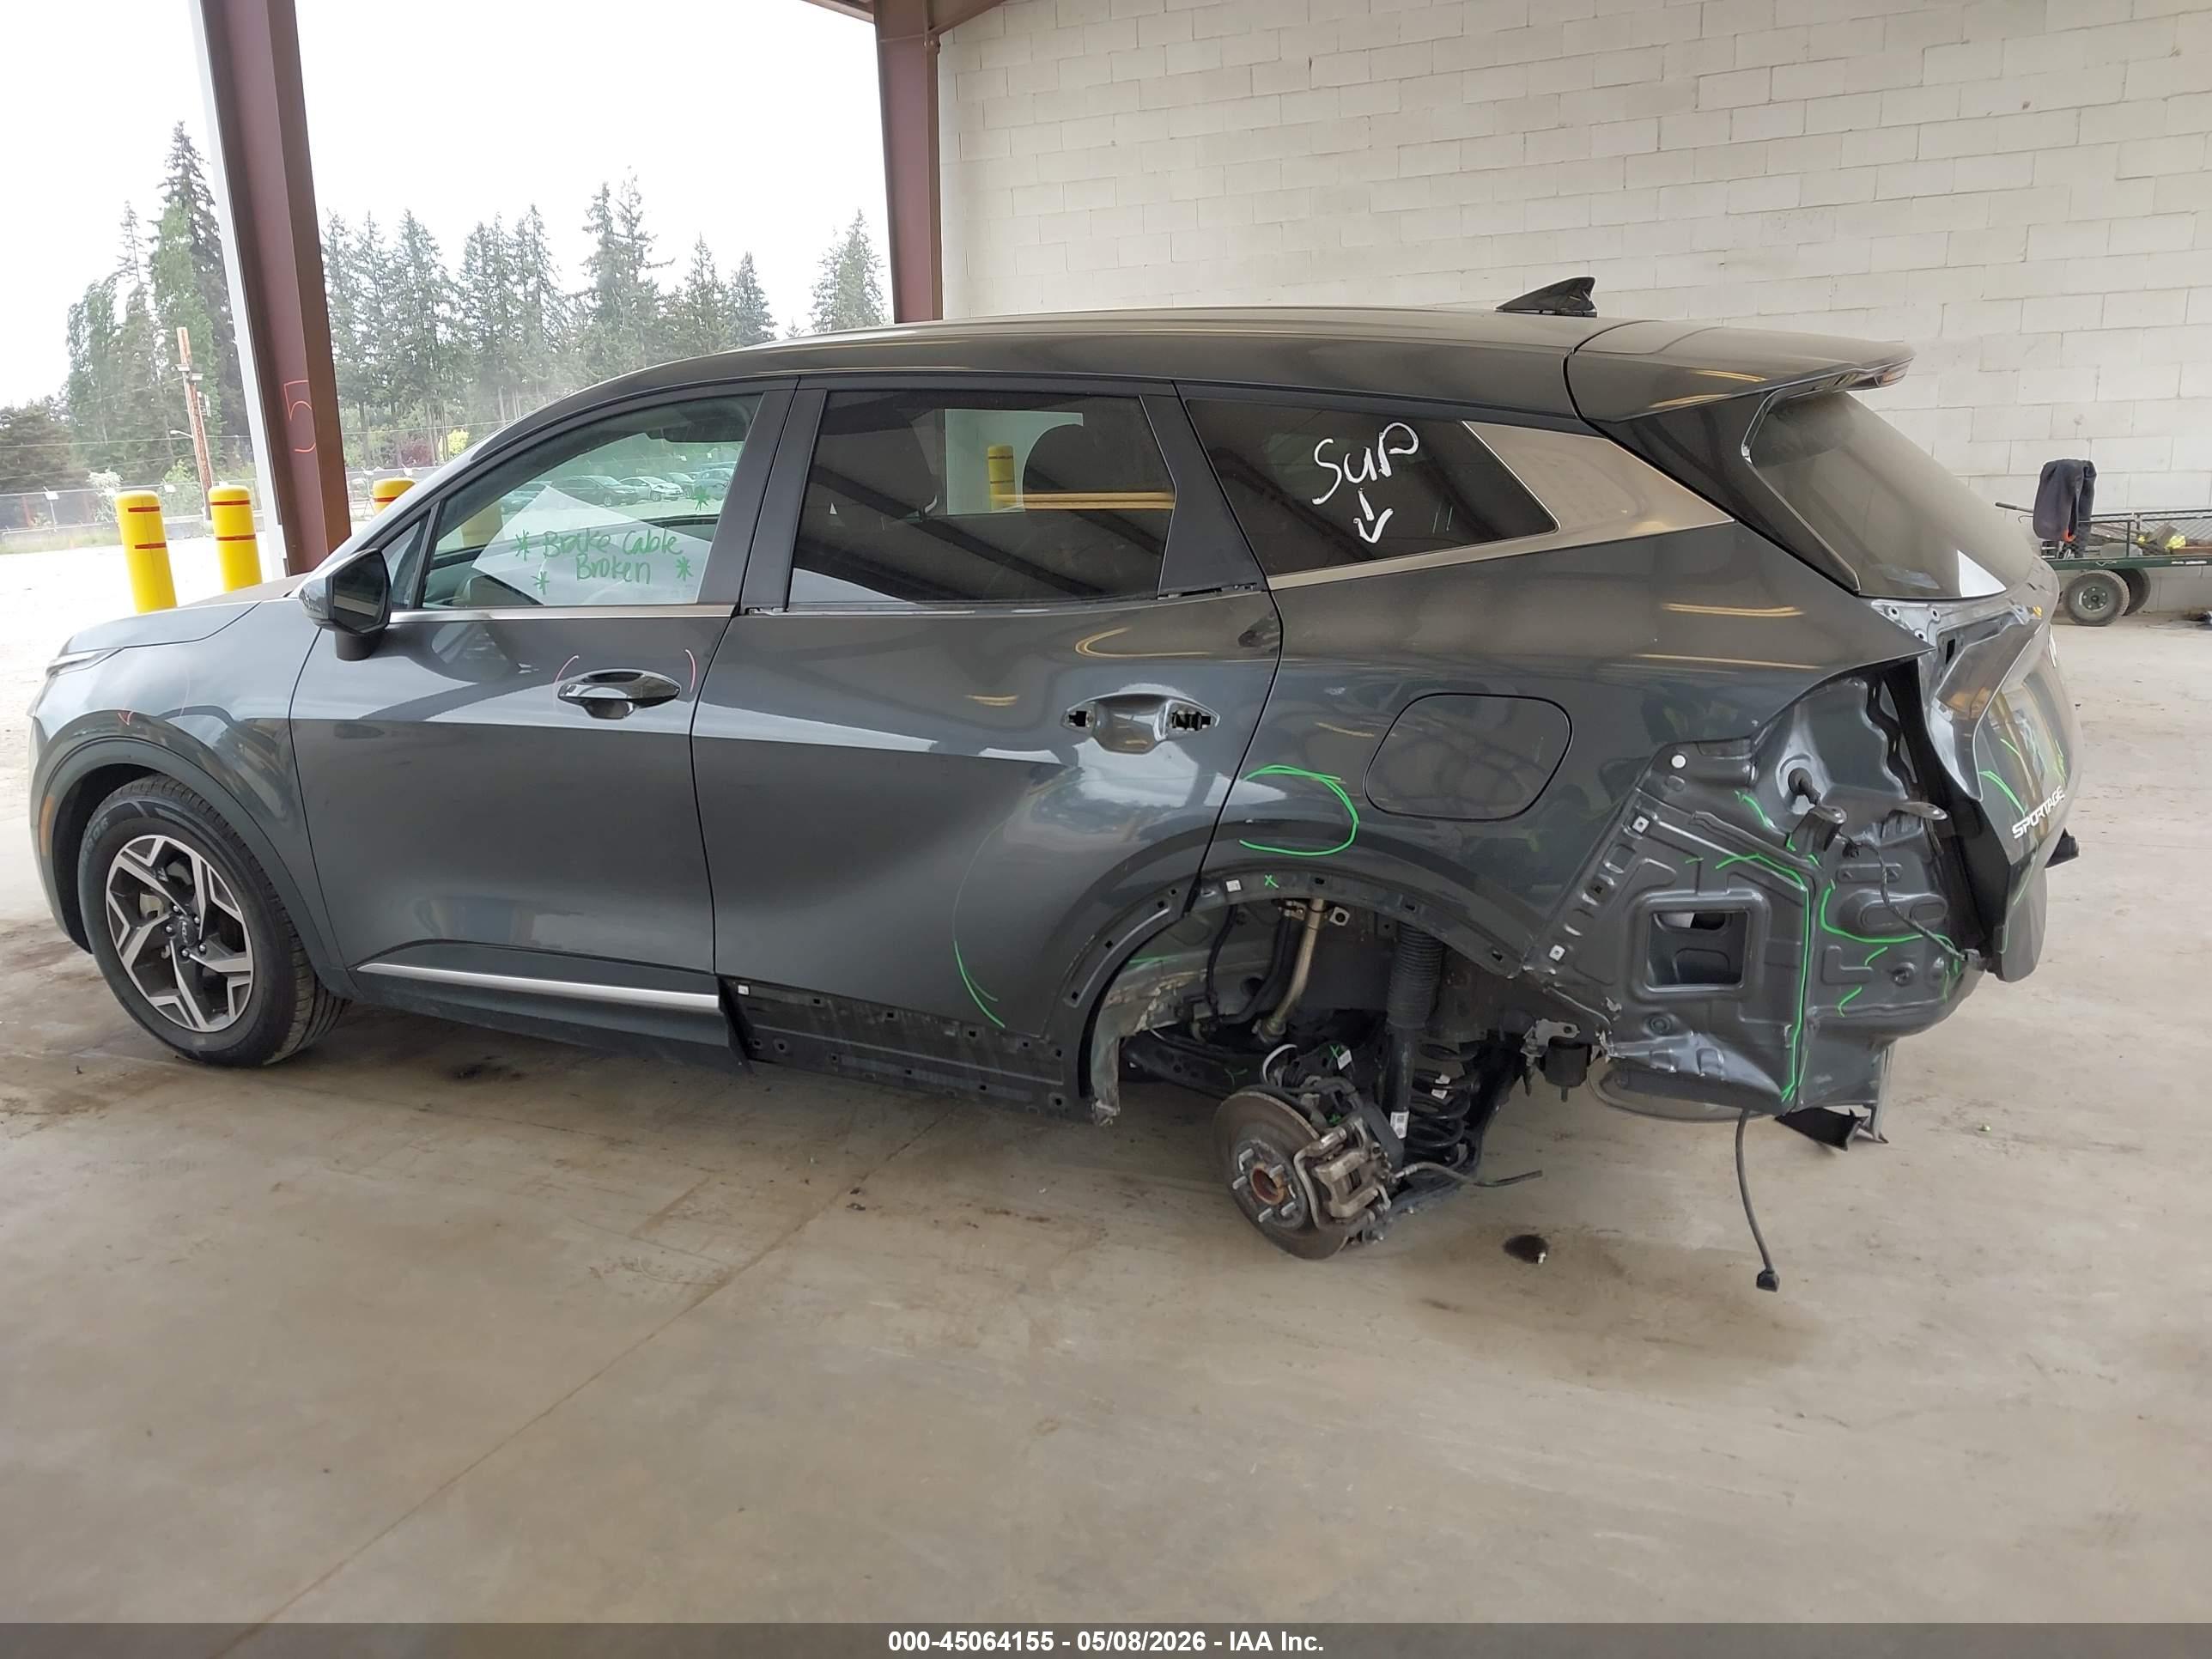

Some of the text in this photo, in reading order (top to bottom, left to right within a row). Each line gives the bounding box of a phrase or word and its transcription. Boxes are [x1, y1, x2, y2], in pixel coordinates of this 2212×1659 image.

[543, 526, 684, 558] Brake Cable
[575, 554, 652, 585] Broken
[2011, 785, 2066, 840] SPORTAGE
